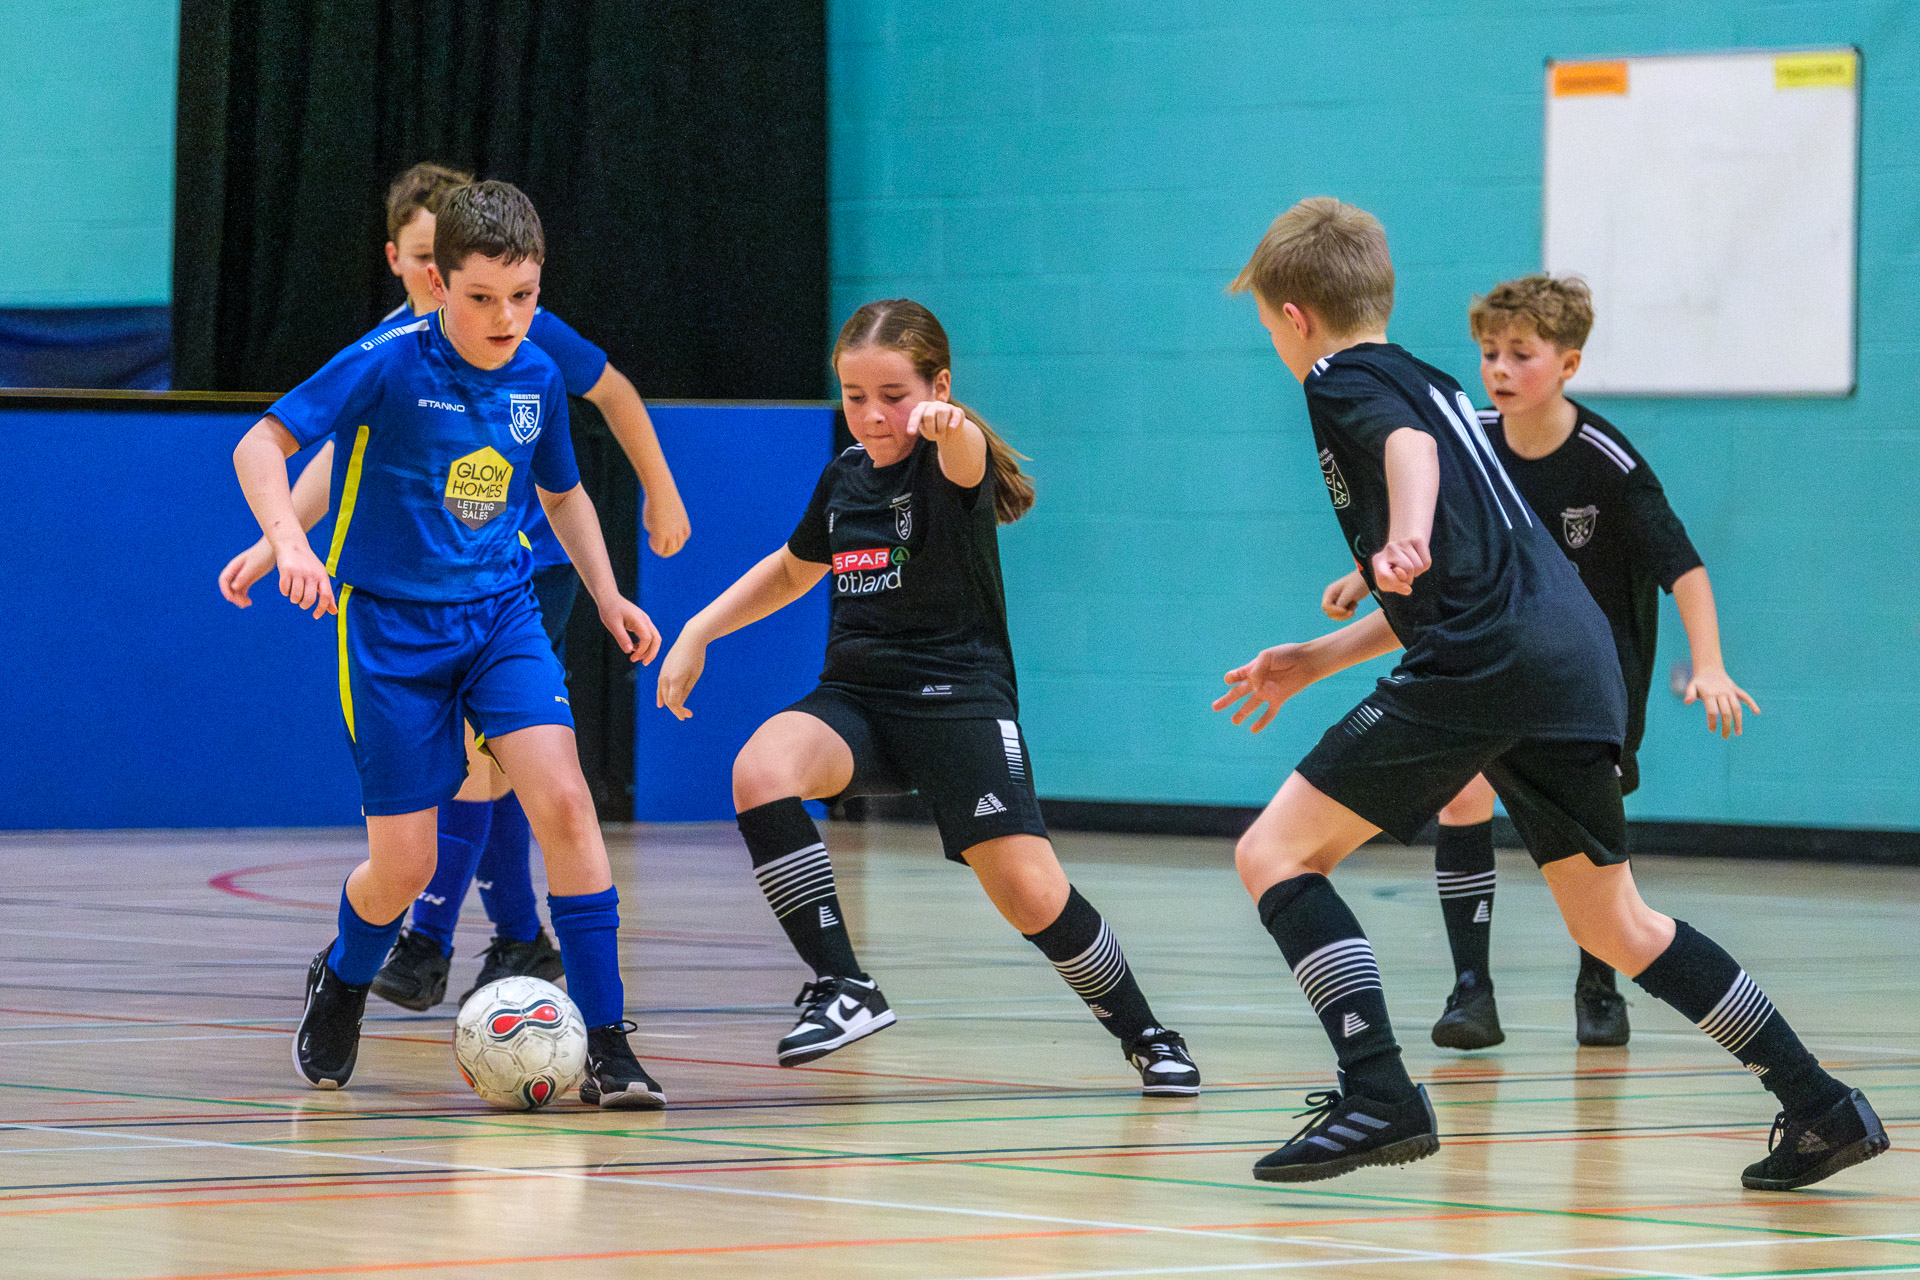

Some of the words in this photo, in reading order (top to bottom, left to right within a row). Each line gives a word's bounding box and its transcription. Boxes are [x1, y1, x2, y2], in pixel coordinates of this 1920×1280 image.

[417, 398, 466, 413] STANNO
[456, 462, 509, 482] GLOW
[452, 480, 503, 498] HOMES
[457, 499, 495, 511] LETTING
[461, 510, 489, 520] SALES
[834, 551, 888, 570] SPAR
[837, 565, 902, 593] otland
